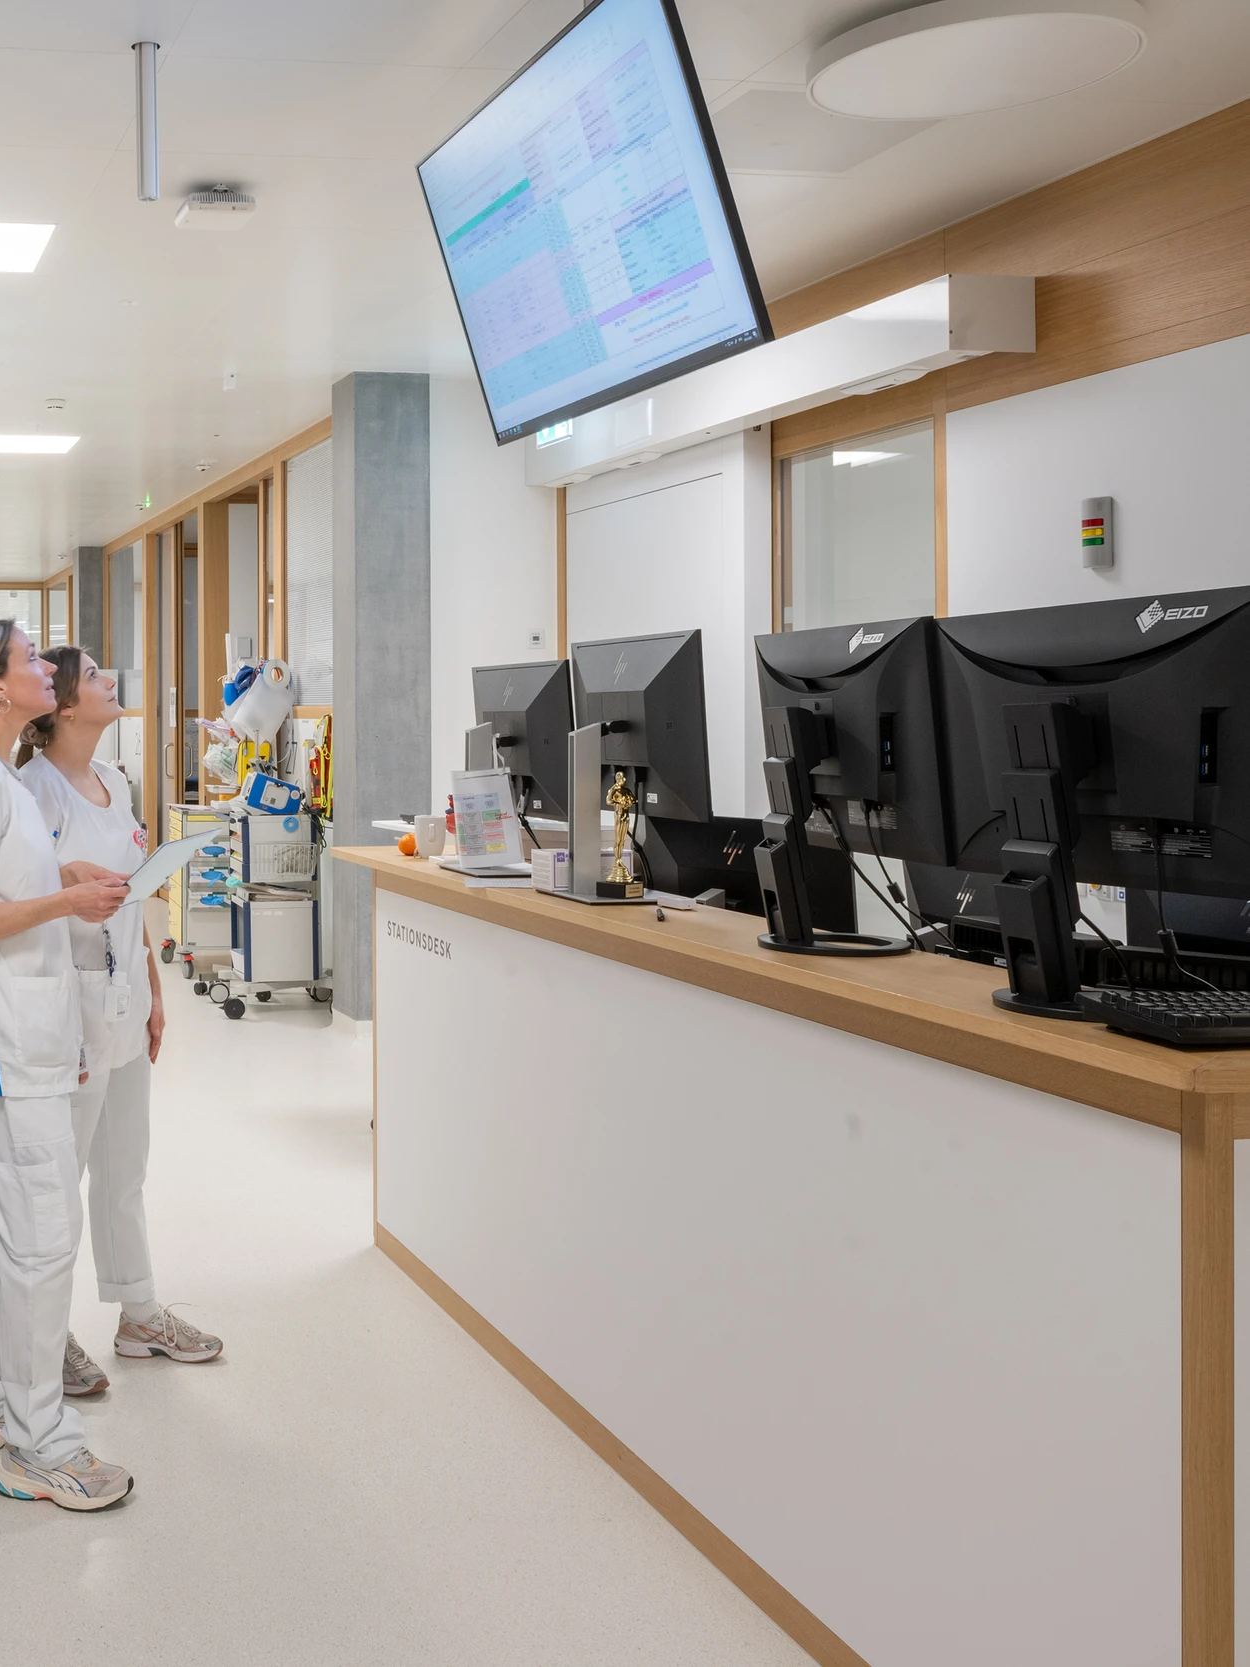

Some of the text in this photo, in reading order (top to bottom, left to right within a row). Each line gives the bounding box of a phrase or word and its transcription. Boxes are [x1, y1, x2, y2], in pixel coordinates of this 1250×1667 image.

[1164, 605, 1209, 621] EIZO
[861, 632, 885, 645] EIZO
[387, 920, 452, 960] STATIONSDESK
